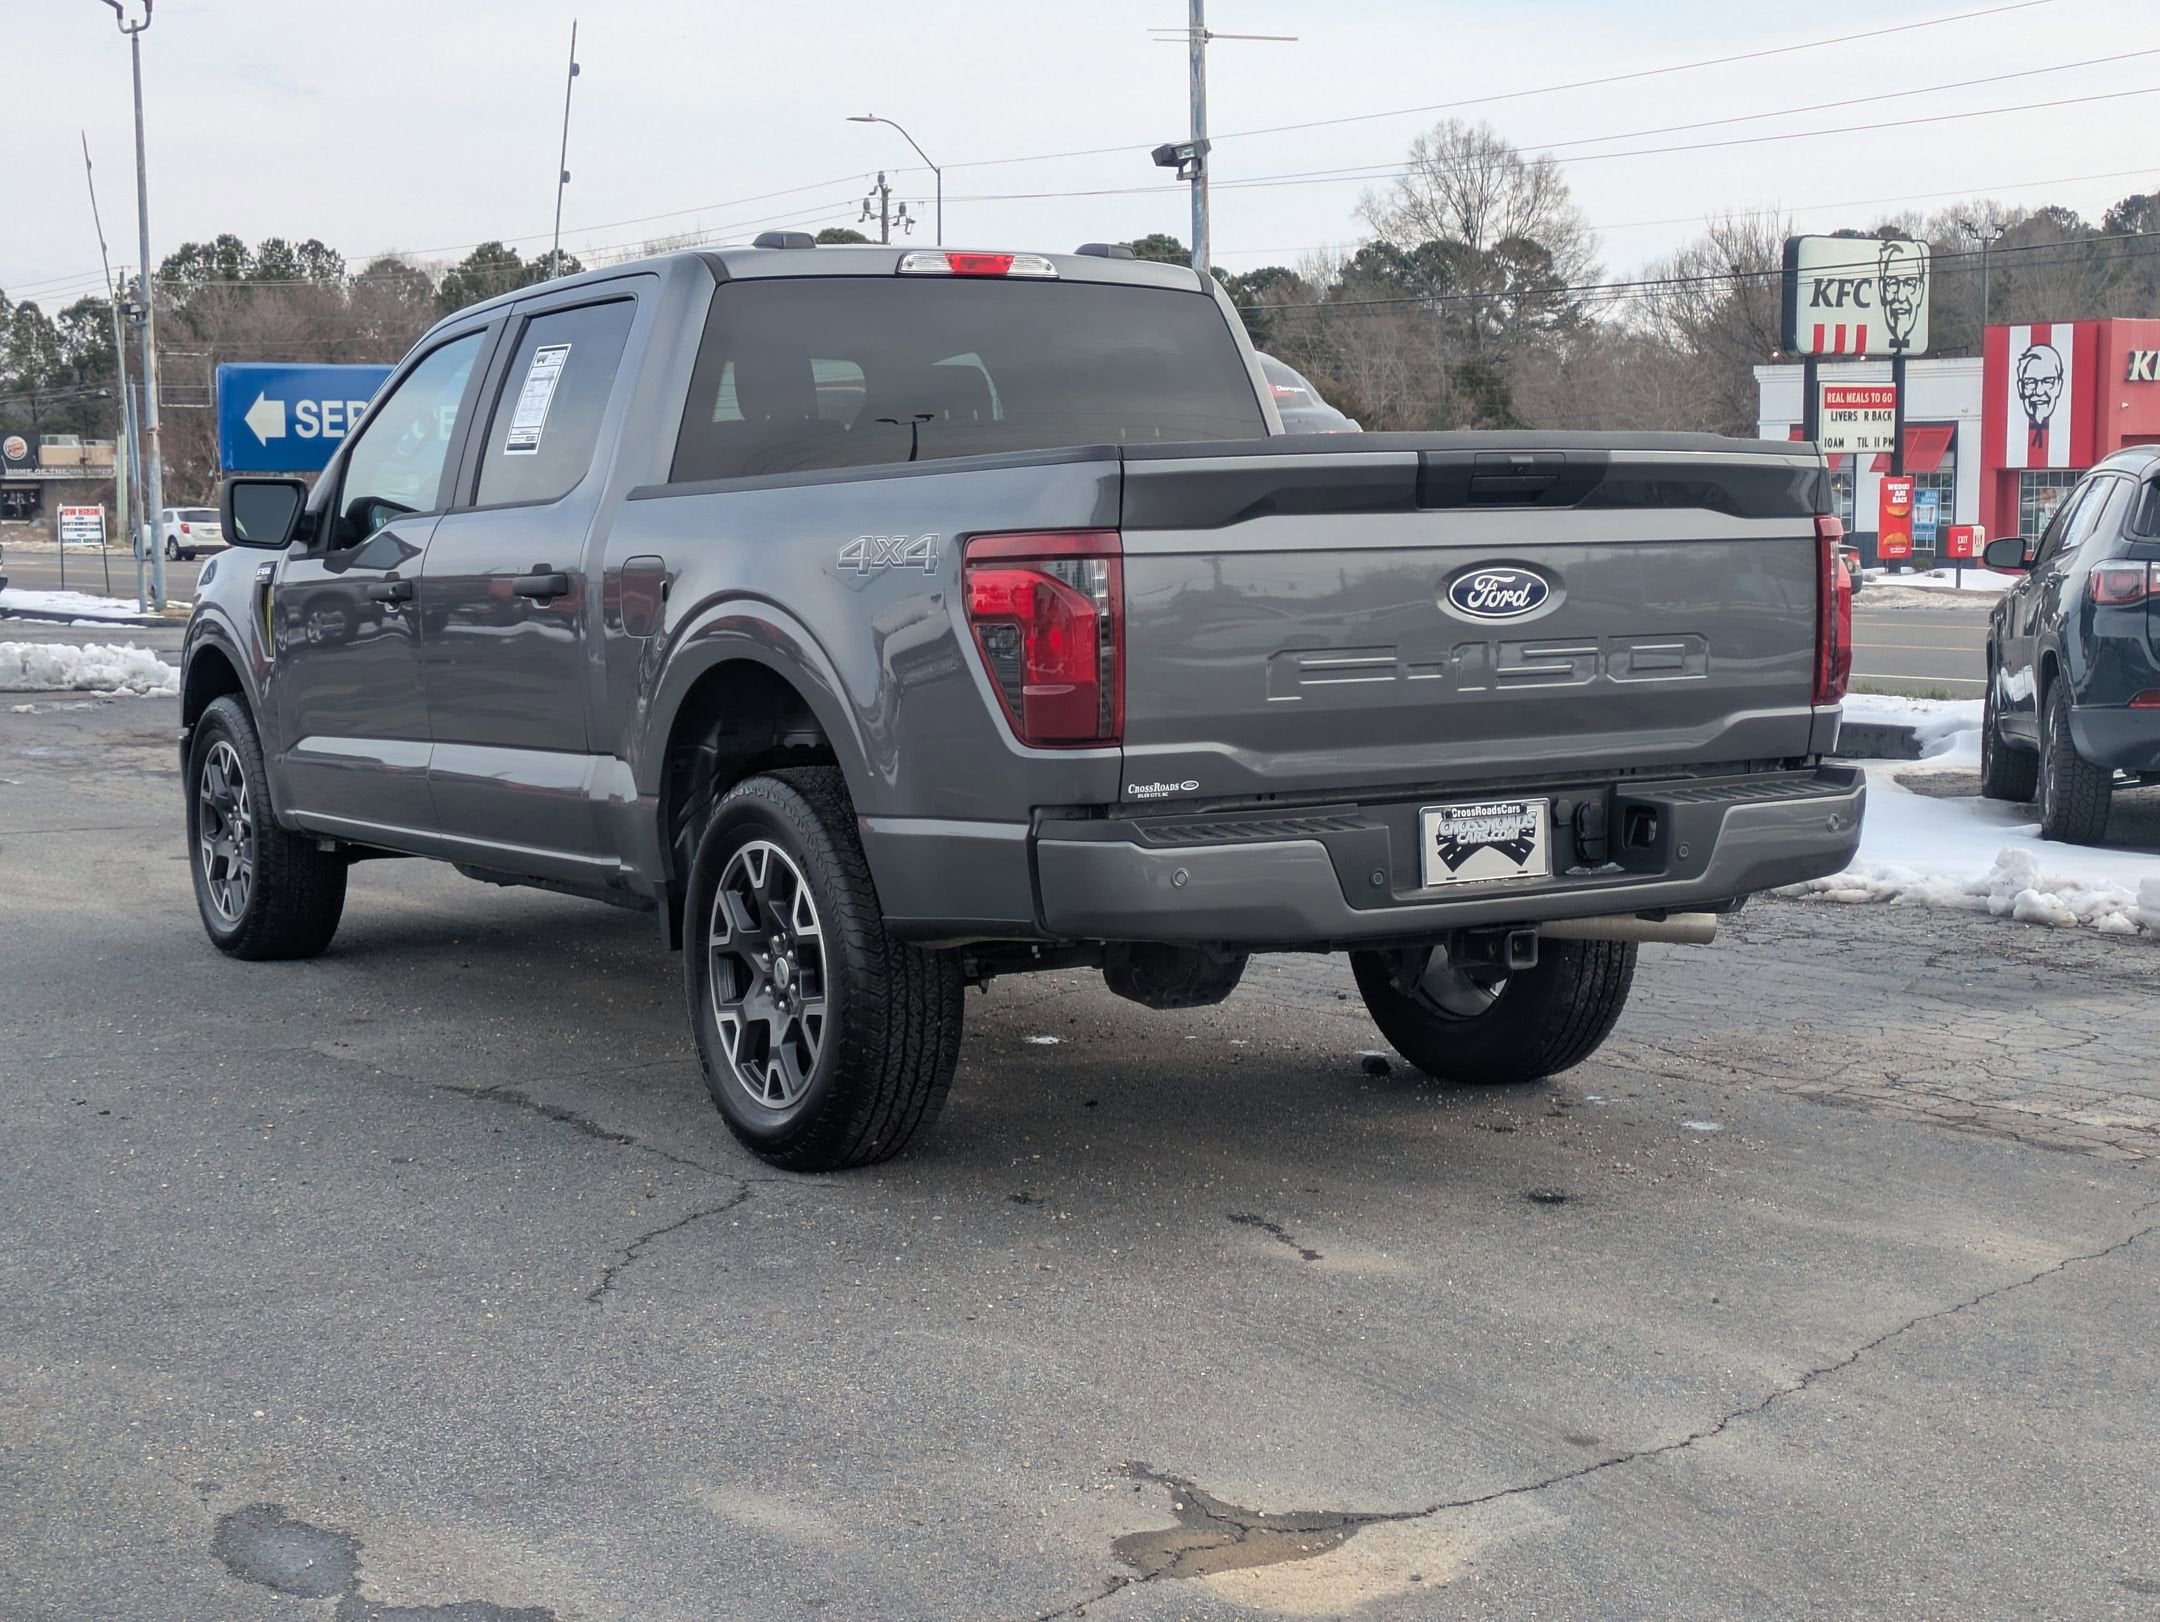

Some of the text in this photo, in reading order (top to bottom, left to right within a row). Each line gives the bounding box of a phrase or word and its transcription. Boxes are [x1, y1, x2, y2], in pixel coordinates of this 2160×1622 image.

[1809, 278, 1873, 308] KFC
[1827, 392, 1893, 403] REAL MEALS TO GO
[1830, 410, 1892, 422] LIVERS R BACK
[1824, 437, 1844, 448] 10AM
[1857, 437, 1869, 448] TIL
[1883, 436, 1894, 447] PM
[1467, 574, 1532, 608] Ford
[1267, 632, 1709, 701] F-150
[1451, 804, 1521, 818] CrossRoadsCars
[1456, 828, 1520, 845] CARS.COM
